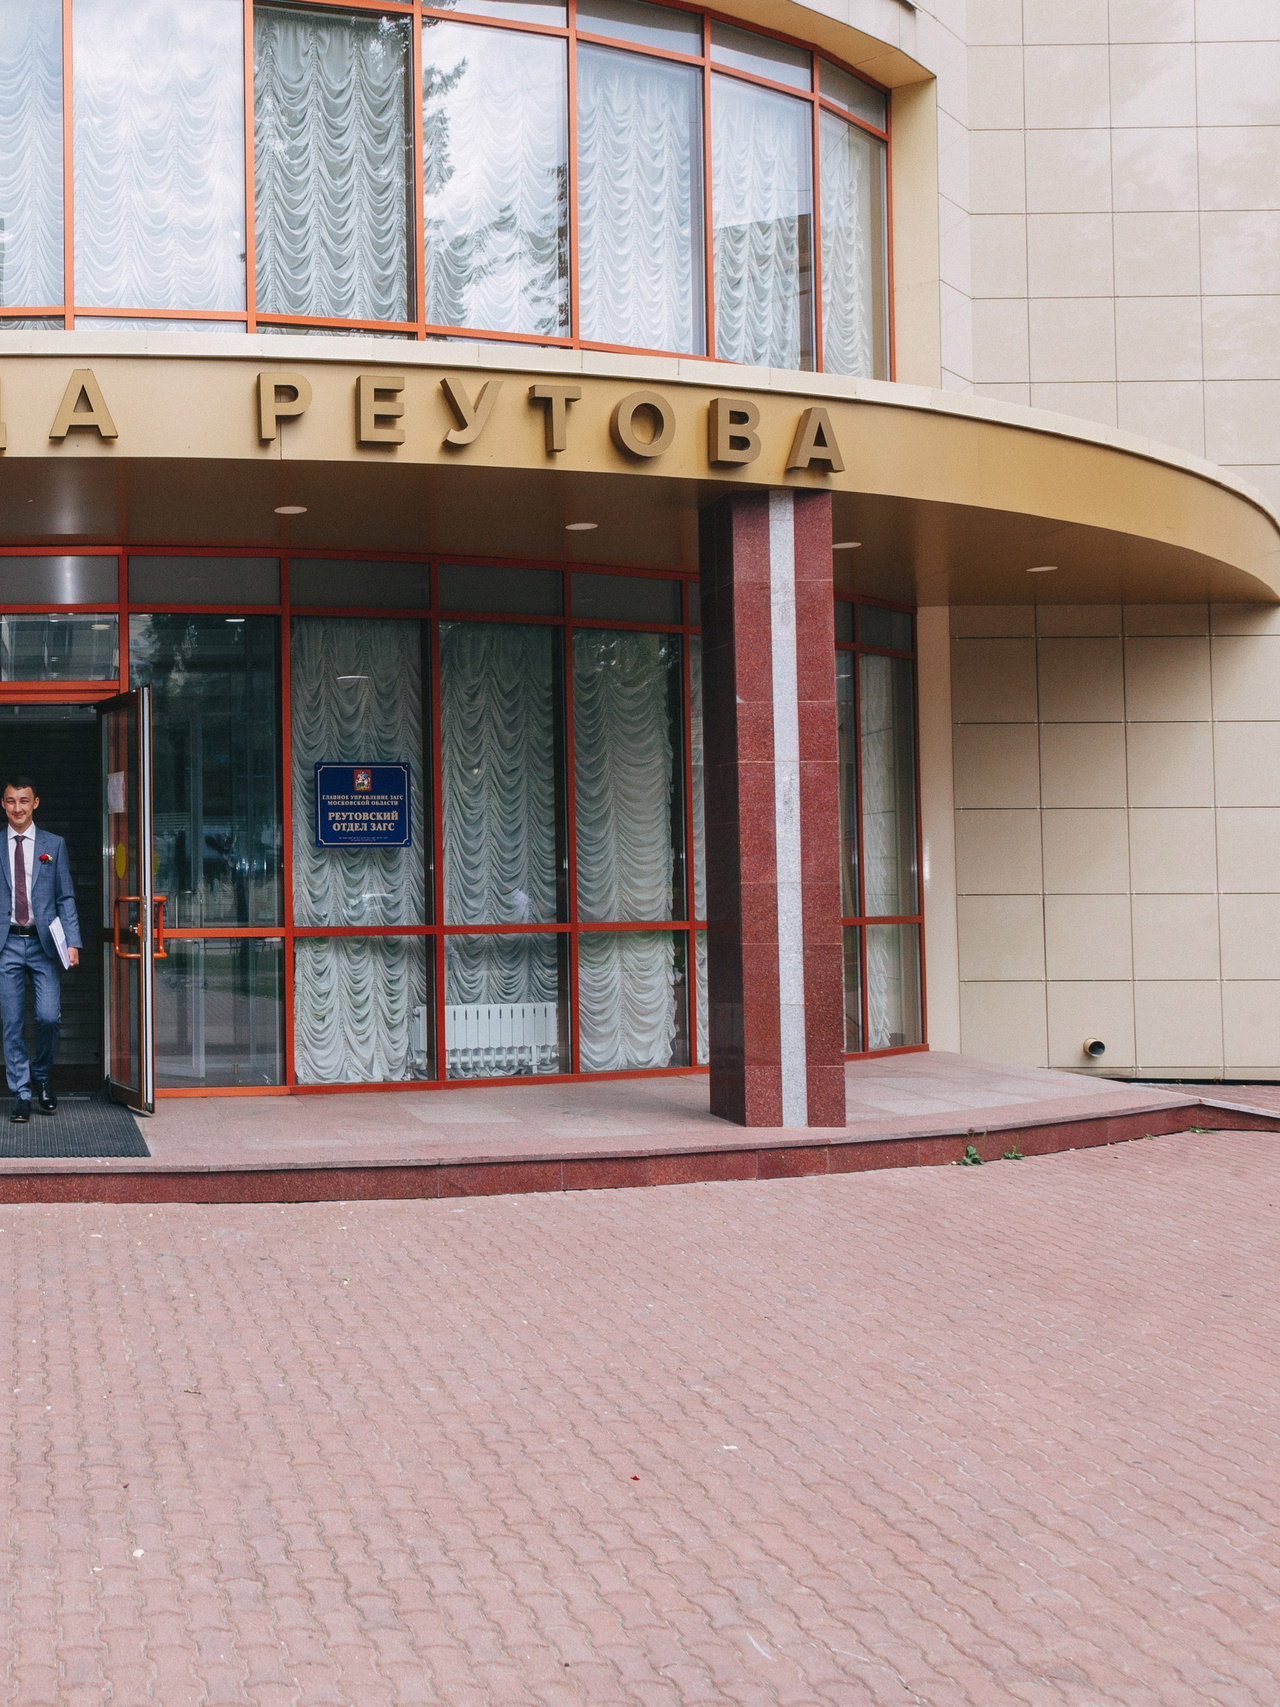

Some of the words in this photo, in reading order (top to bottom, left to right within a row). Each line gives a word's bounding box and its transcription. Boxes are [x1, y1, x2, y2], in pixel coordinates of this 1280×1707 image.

[256, 370, 846, 474] РЕУТОВА
[328, 810, 399, 821] РЕУТОВСКИЙ
[332, 822, 368, 832] ОТДЕЛ
[370, 822, 395, 832] ЗАГС
